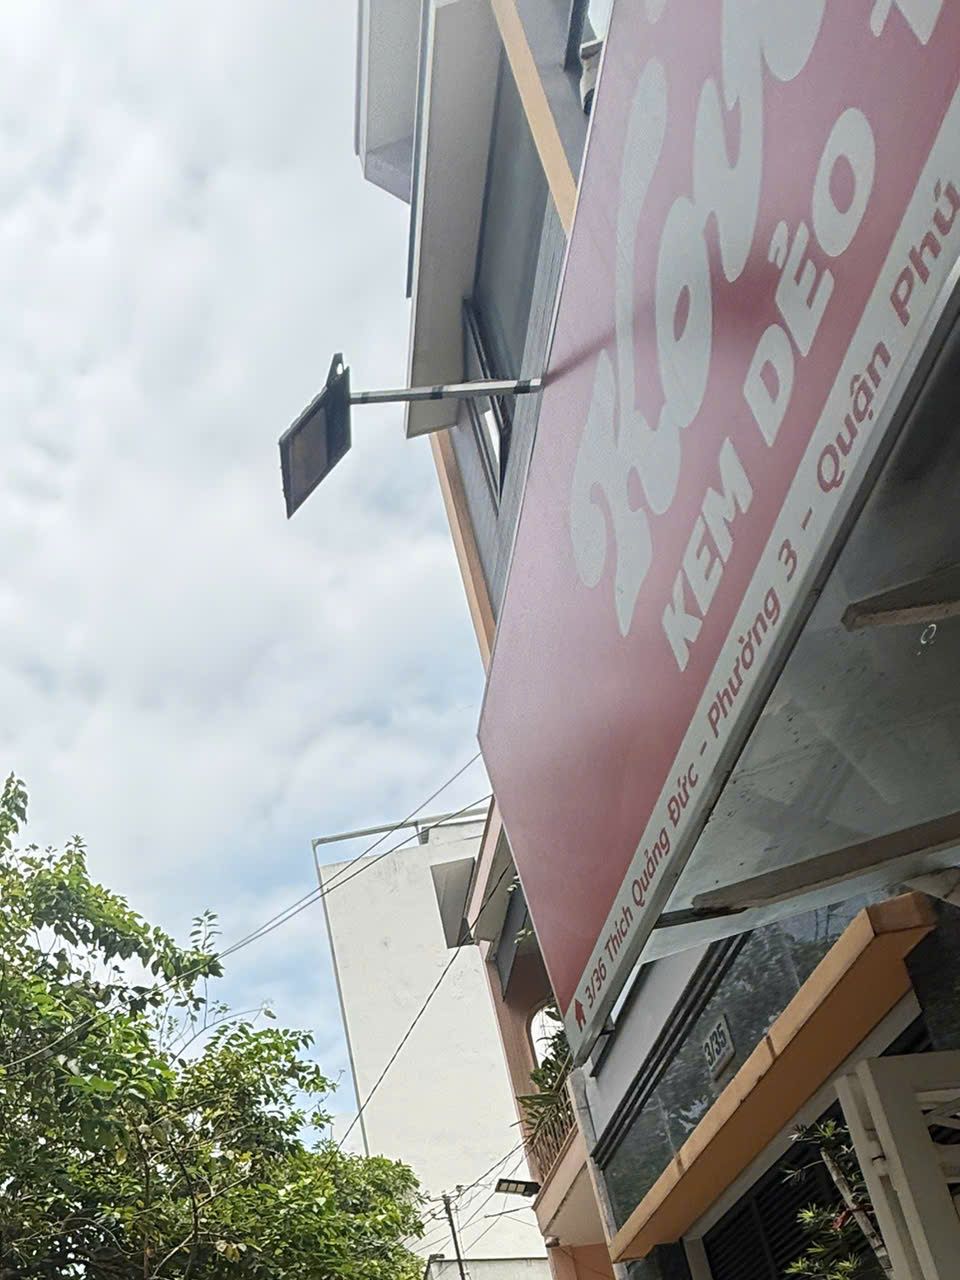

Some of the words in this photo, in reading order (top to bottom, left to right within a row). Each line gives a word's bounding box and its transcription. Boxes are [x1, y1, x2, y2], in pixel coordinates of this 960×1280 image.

[585, 957, 608, 1010] 3/36
[604, 905, 634, 963] Thích
[631, 827, 670, 908] Quảng
[667, 762, 700, 828] Đức
[707, 586, 781, 739] Phường
[778, 538, 798, 583] 3
[816, 340, 892, 494] Quận
[890, 176, 960, 328] Phú
[661, 436, 753, 673] KEM
[743, 106, 876, 448] DẺO
[703, 1022, 727, 1067] 3/35
